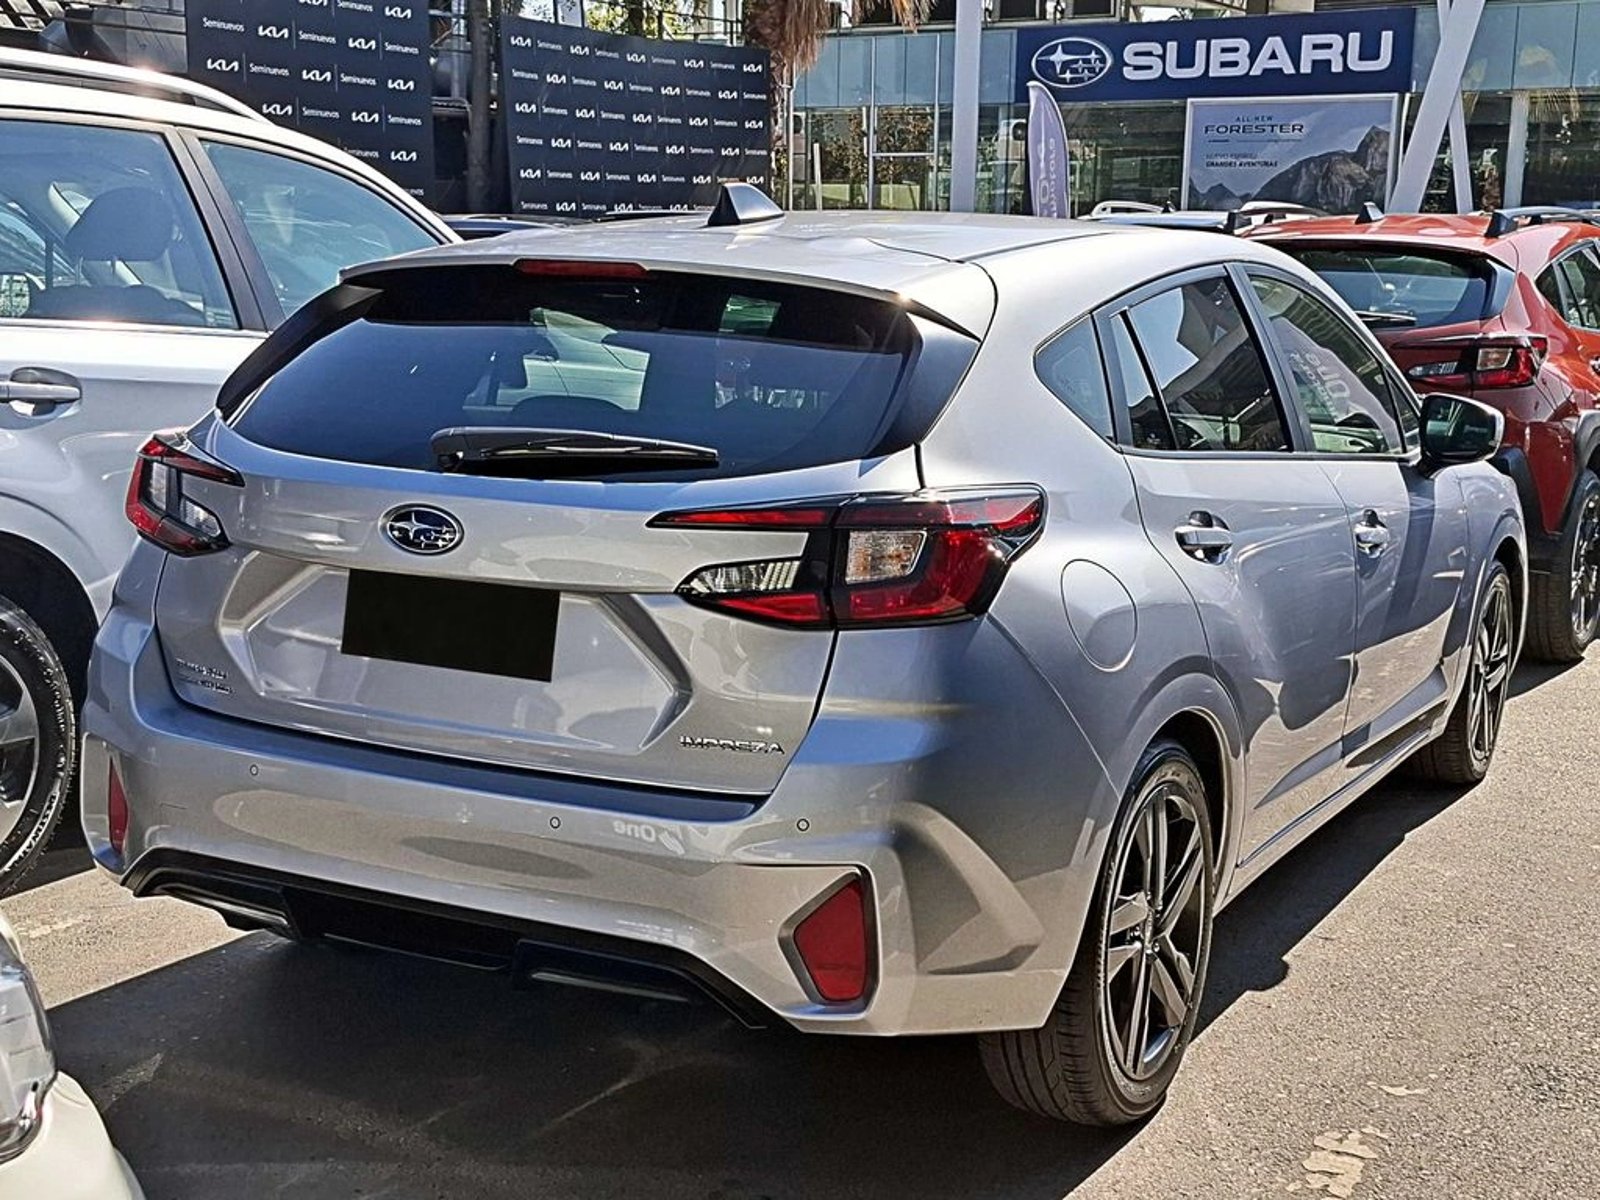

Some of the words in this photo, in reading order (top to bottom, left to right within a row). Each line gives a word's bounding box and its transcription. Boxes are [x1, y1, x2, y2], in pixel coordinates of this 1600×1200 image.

[203, 17, 244, 32] Seminuevos
[298, 31, 336, 44] Seminuevos
[384, 42, 419, 54] Seminuevos
[1122, 31, 1393, 81] SUBARU
[250, 63, 289, 76] Seminuevos
[341, 73, 376, 85] Seminuevos
[302, 107, 339, 118] Seminuevos
[388, 115, 422, 125] Seminuevos
[1204, 124, 1304, 134] FORESTER
[680, 736, 785, 754] IMPREZA
